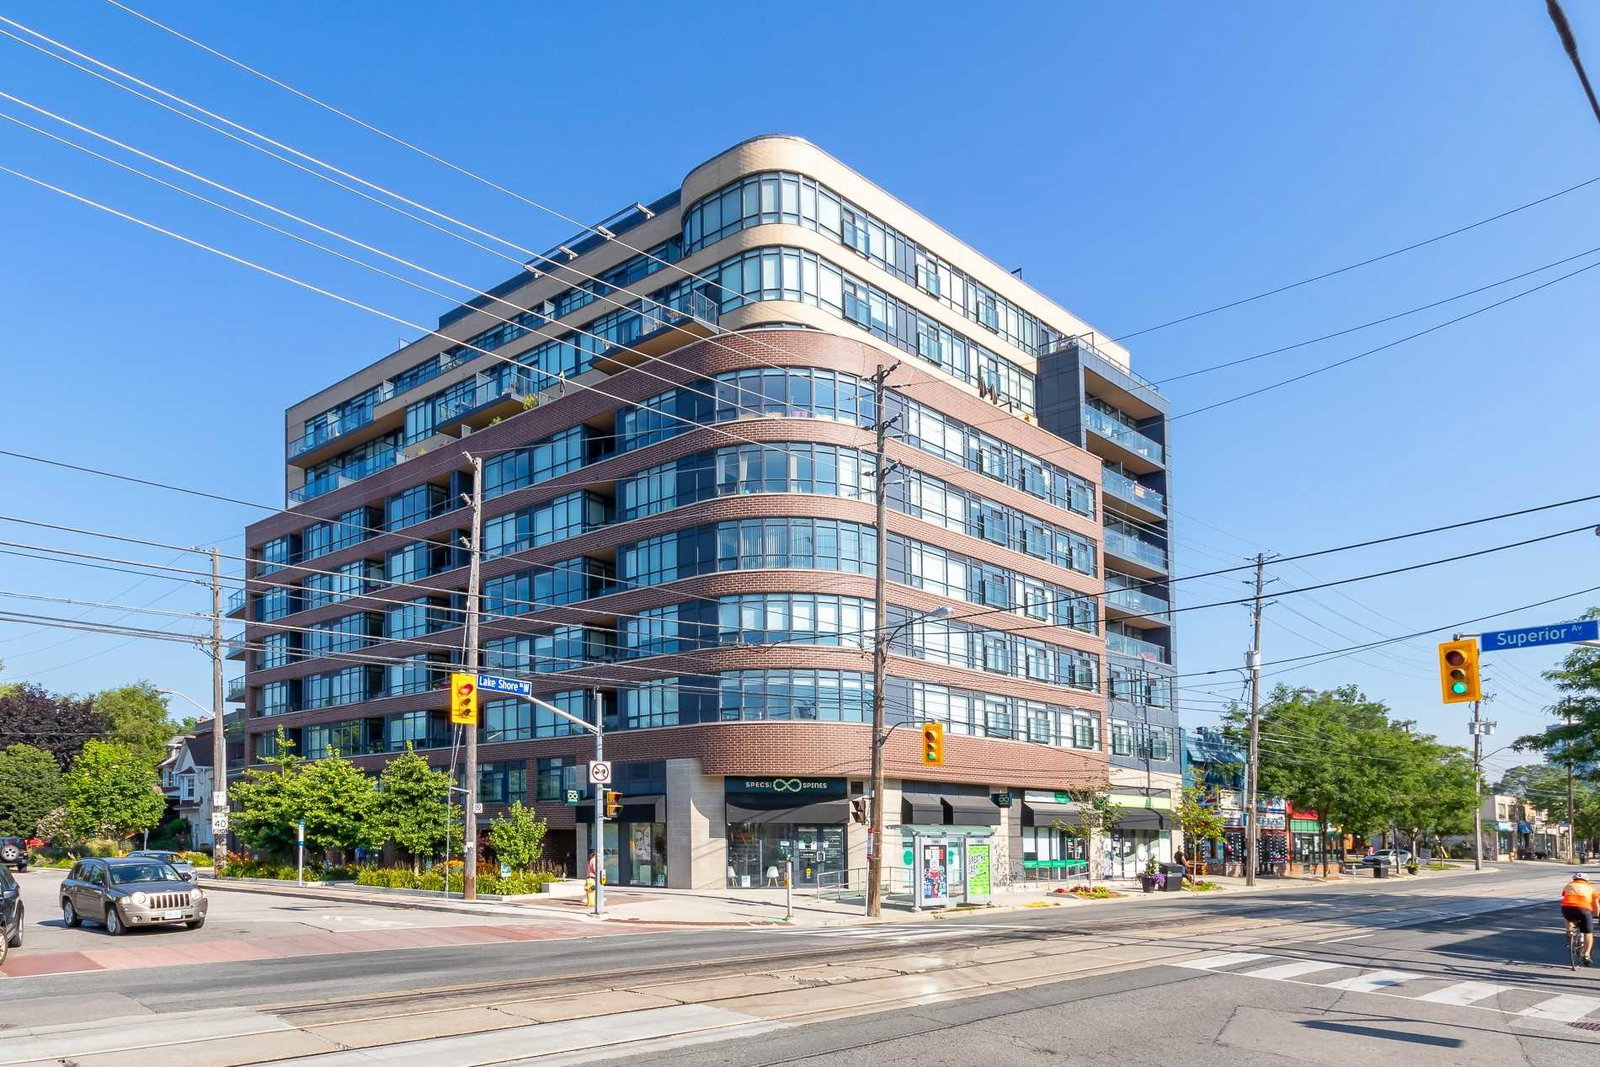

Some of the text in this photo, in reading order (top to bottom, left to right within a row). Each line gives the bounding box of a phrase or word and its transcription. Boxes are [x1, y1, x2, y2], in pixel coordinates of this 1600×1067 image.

[1496, 624, 1583, 647] Superior Av
[479, 675, 496, 688] Lake
[498, 679, 519, 691] Shore
[523, 683, 530, 693] W
[214, 819, 227, 828] 40
